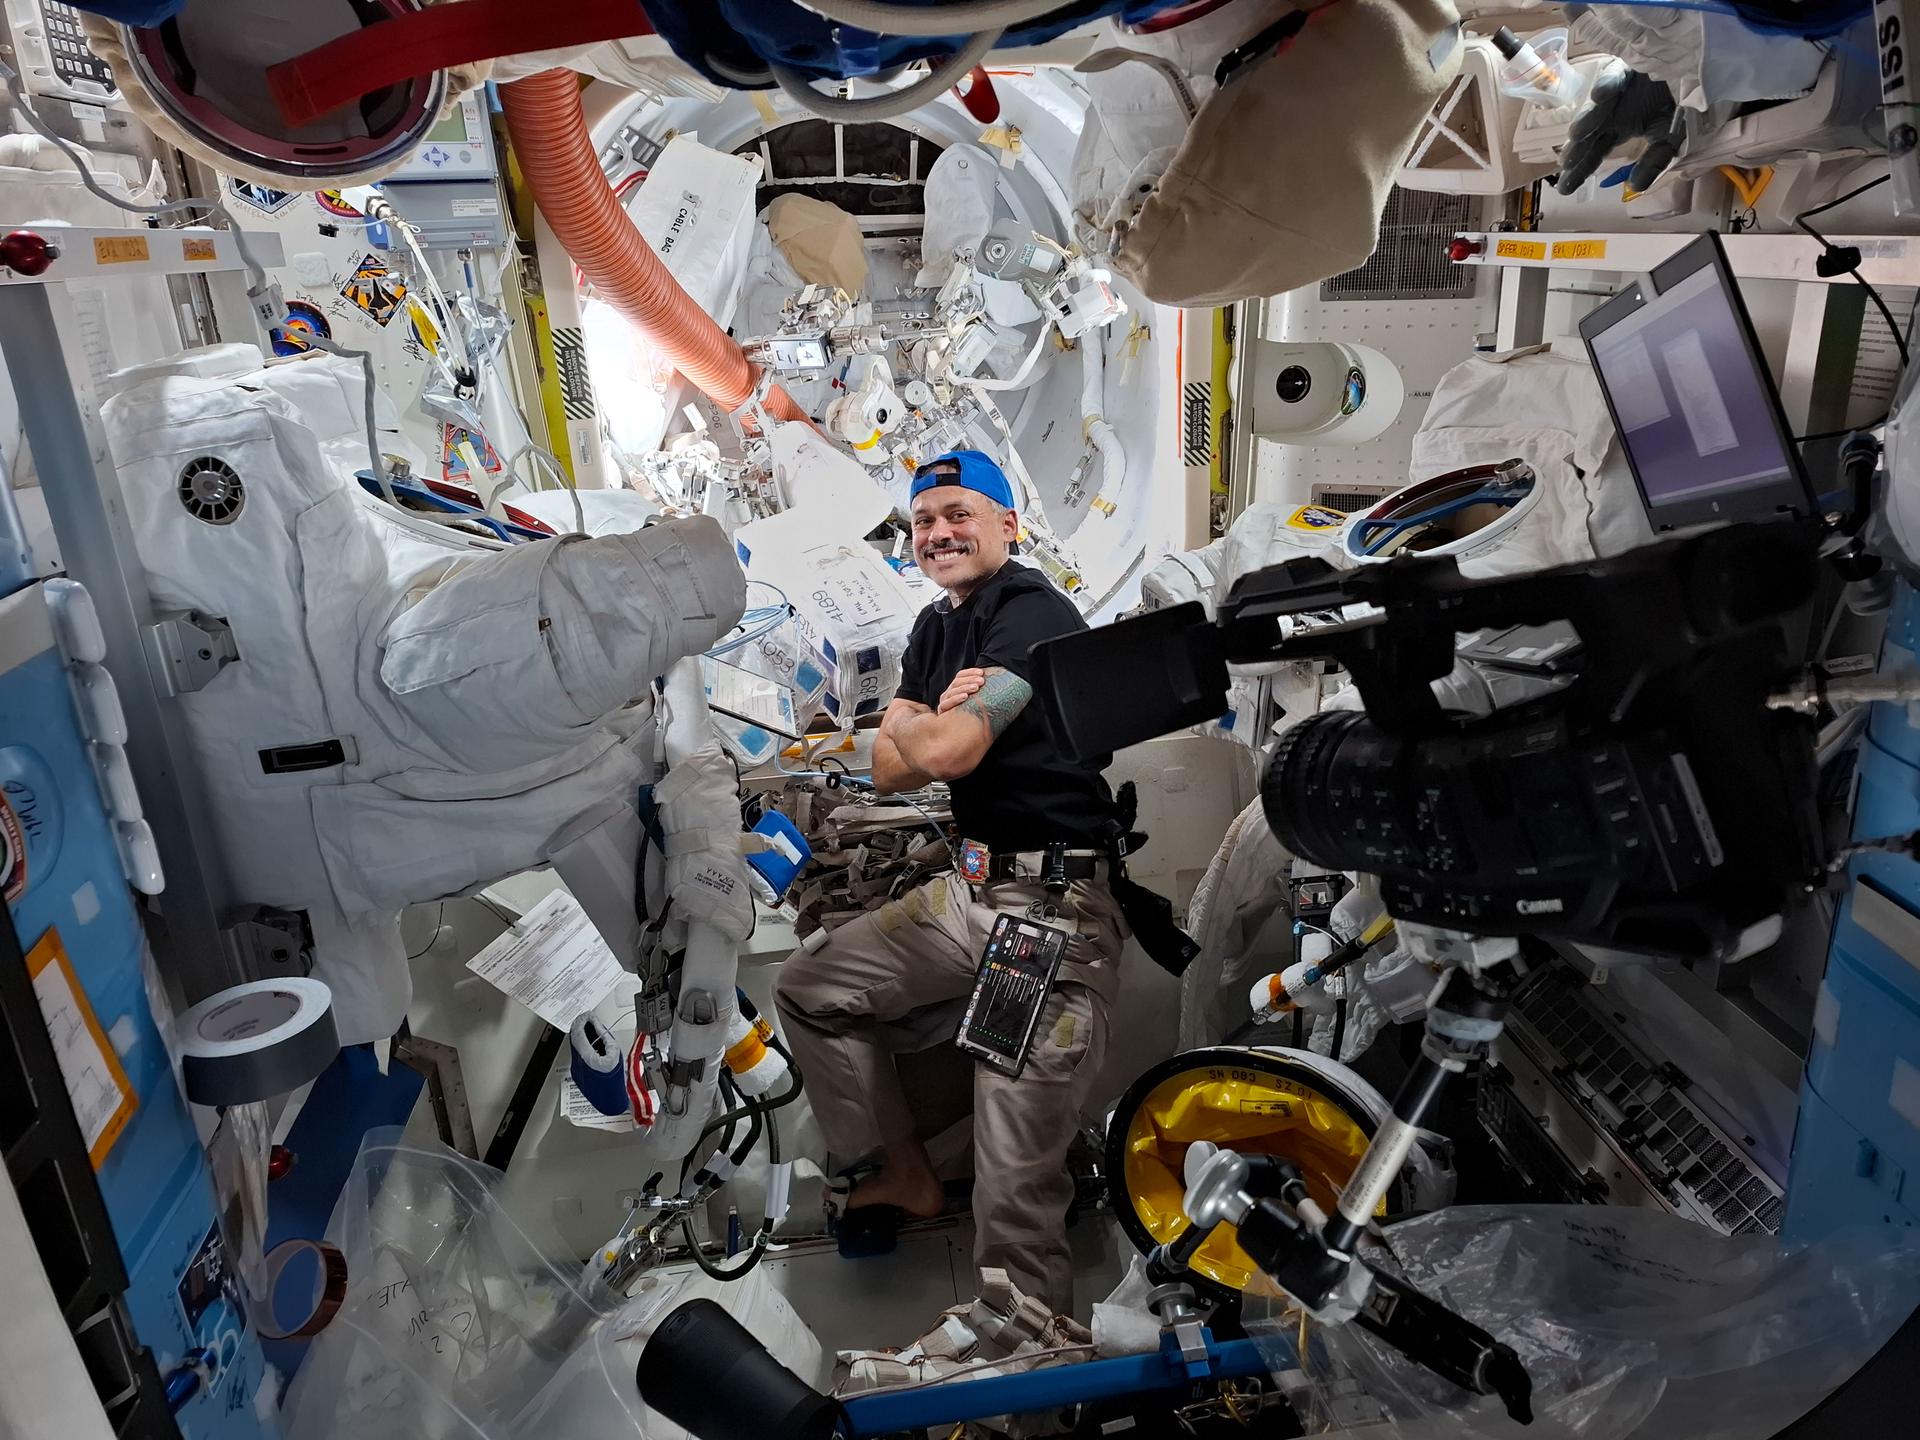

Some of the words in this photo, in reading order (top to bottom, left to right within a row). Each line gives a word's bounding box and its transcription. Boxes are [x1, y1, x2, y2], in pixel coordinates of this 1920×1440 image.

[1879, 15, 1904, 95] ISS
[671, 208, 688, 233] CABLE
[661, 236, 675, 253] BAG
[564, 350, 572, 370] HATCH
[570, 349, 579, 374] REMOVE
[567, 371, 577, 398] CLOSURE
[574, 374, 583, 398] BEFORE
[812, 589, 844, 623] 4189
[1209, 1069, 1224, 1080] SN
